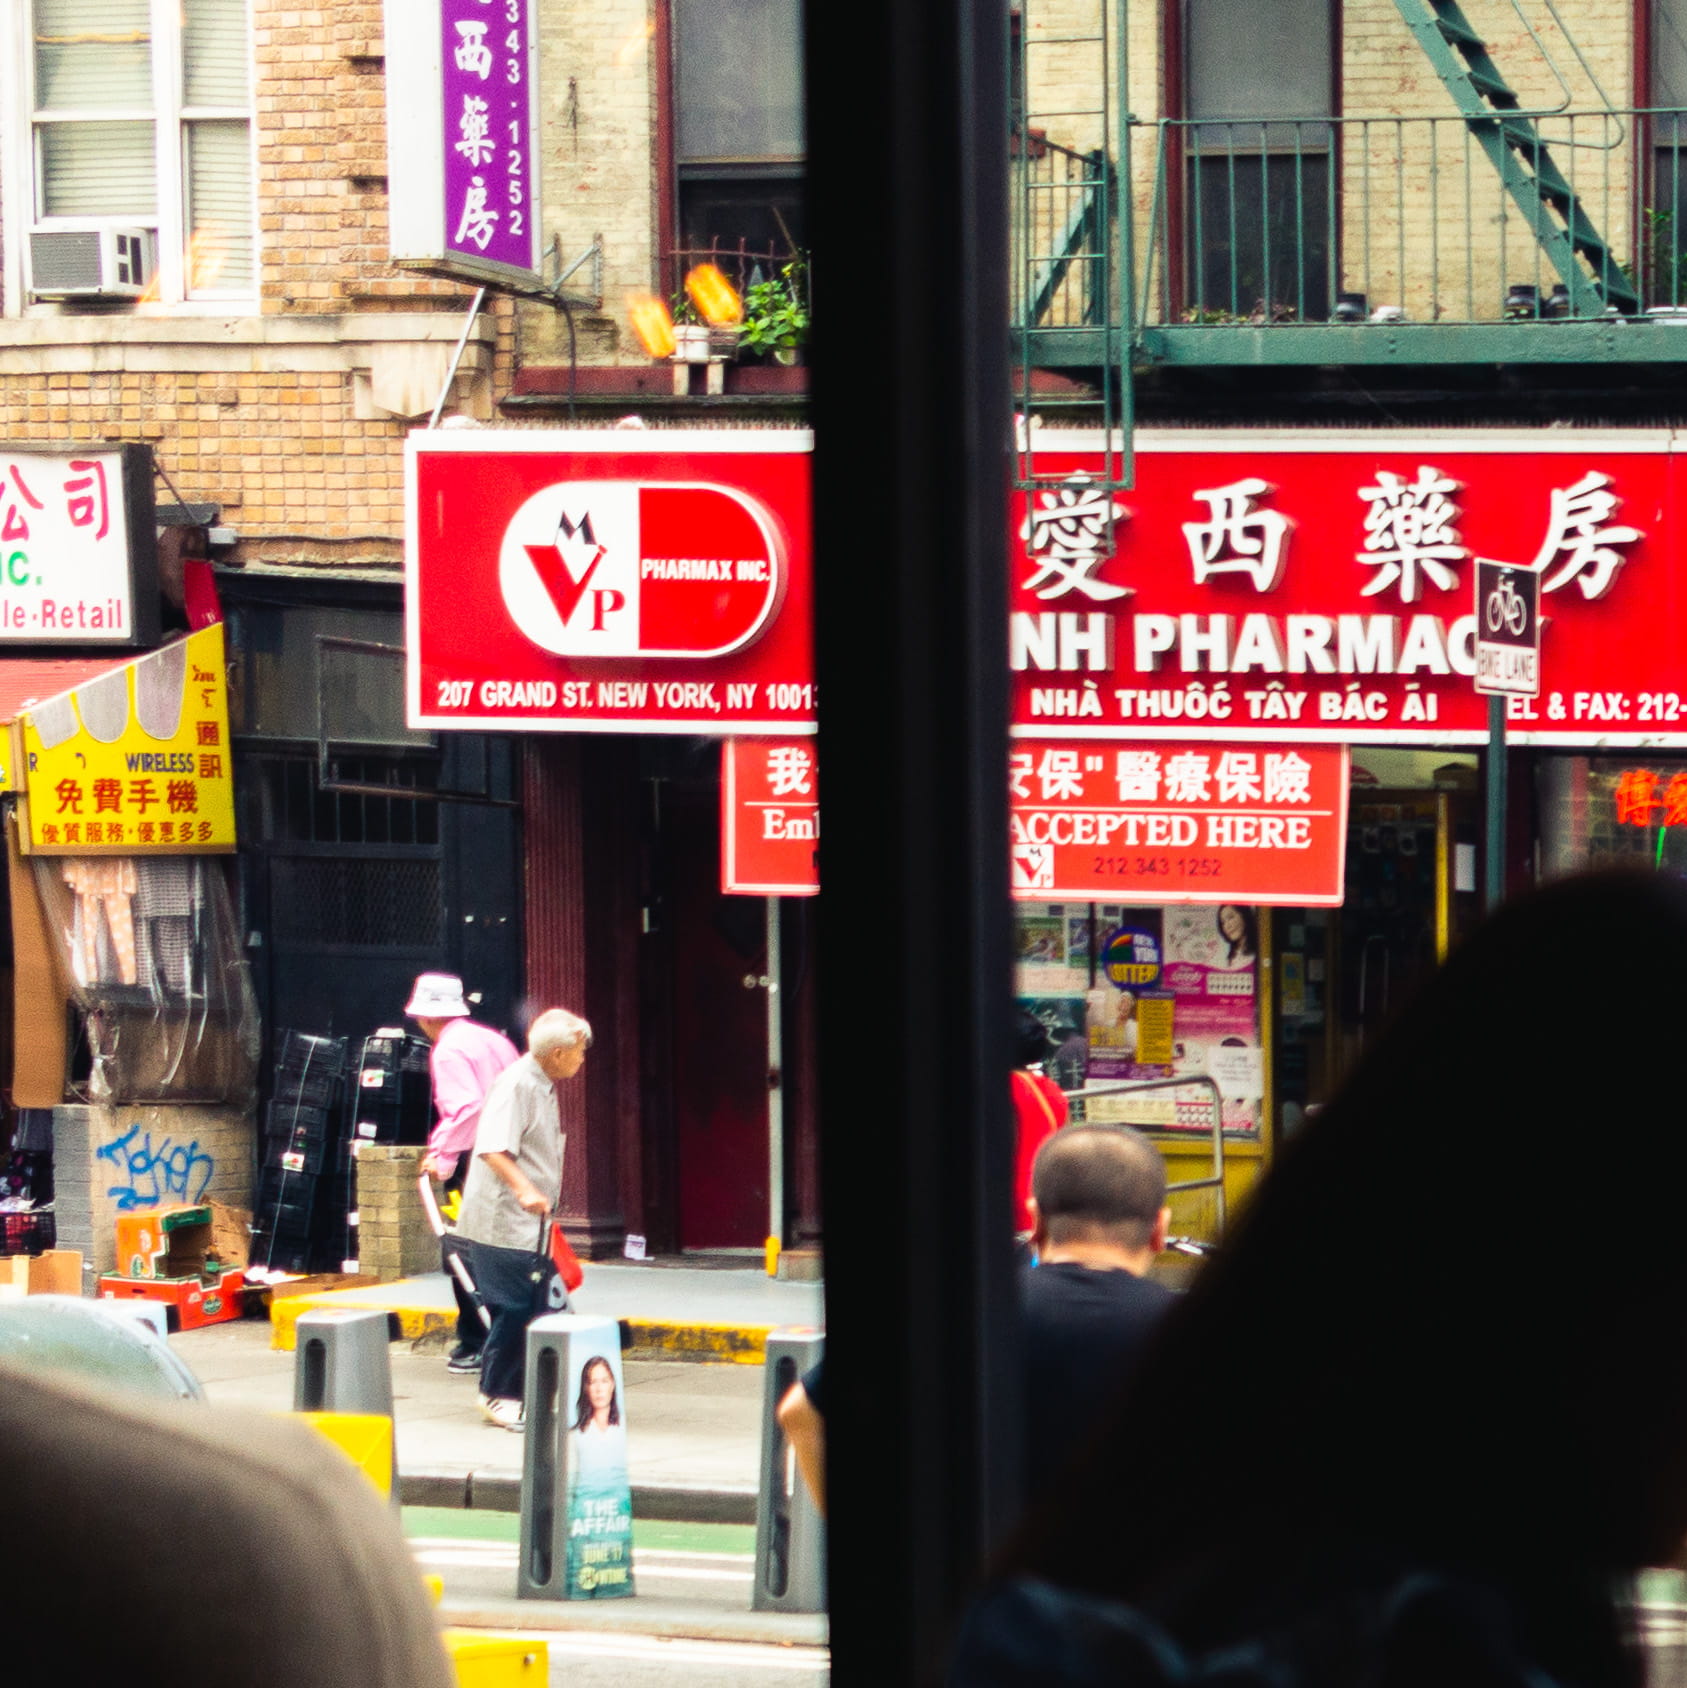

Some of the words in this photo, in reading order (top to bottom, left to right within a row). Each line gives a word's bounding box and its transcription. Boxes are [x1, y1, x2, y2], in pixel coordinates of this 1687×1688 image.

[454, 0, 499, 250] 西藥房
[641, 559, 732, 582] PHARMAX
[737, 560, 771, 582] INC.
[1134, 613, 1545, 677] PHARMAC
[438, 681, 474, 708] 207
[481, 682, 556, 709] GRAND
[563, 682, 593, 709] ST.
[599, 683, 648, 709] NEW
[657, 683, 721, 713] YORK,
[727, 684, 756, 710] NY
[1031, 679, 1103, 717] NHÀ
[1244, 682, 1306, 721] TÂY
[1319, 683, 1388, 721] BÁC
[1401, 683, 1438, 722] ÁI
[1507, 695, 1539, 721] EL
[1547, 693, 1567, 721] &
[1573, 693, 1631, 722] FAX:
[125, 752, 195, 773] WIRELESS
[766, 746, 812, 796] 我
[55, 778, 198, 815] 免費手機
[1010, 813, 1199, 847] ACCEPTED
[1206, 815, 1312, 849] HERE
[1093, 857, 1129, 876] 212
[1136, 857, 1170, 876] 343
[1179, 858, 1223, 877] 1252
[583, 1499, 620, 1518] THE
[571, 1515, 631, 1538] AFFAIR
